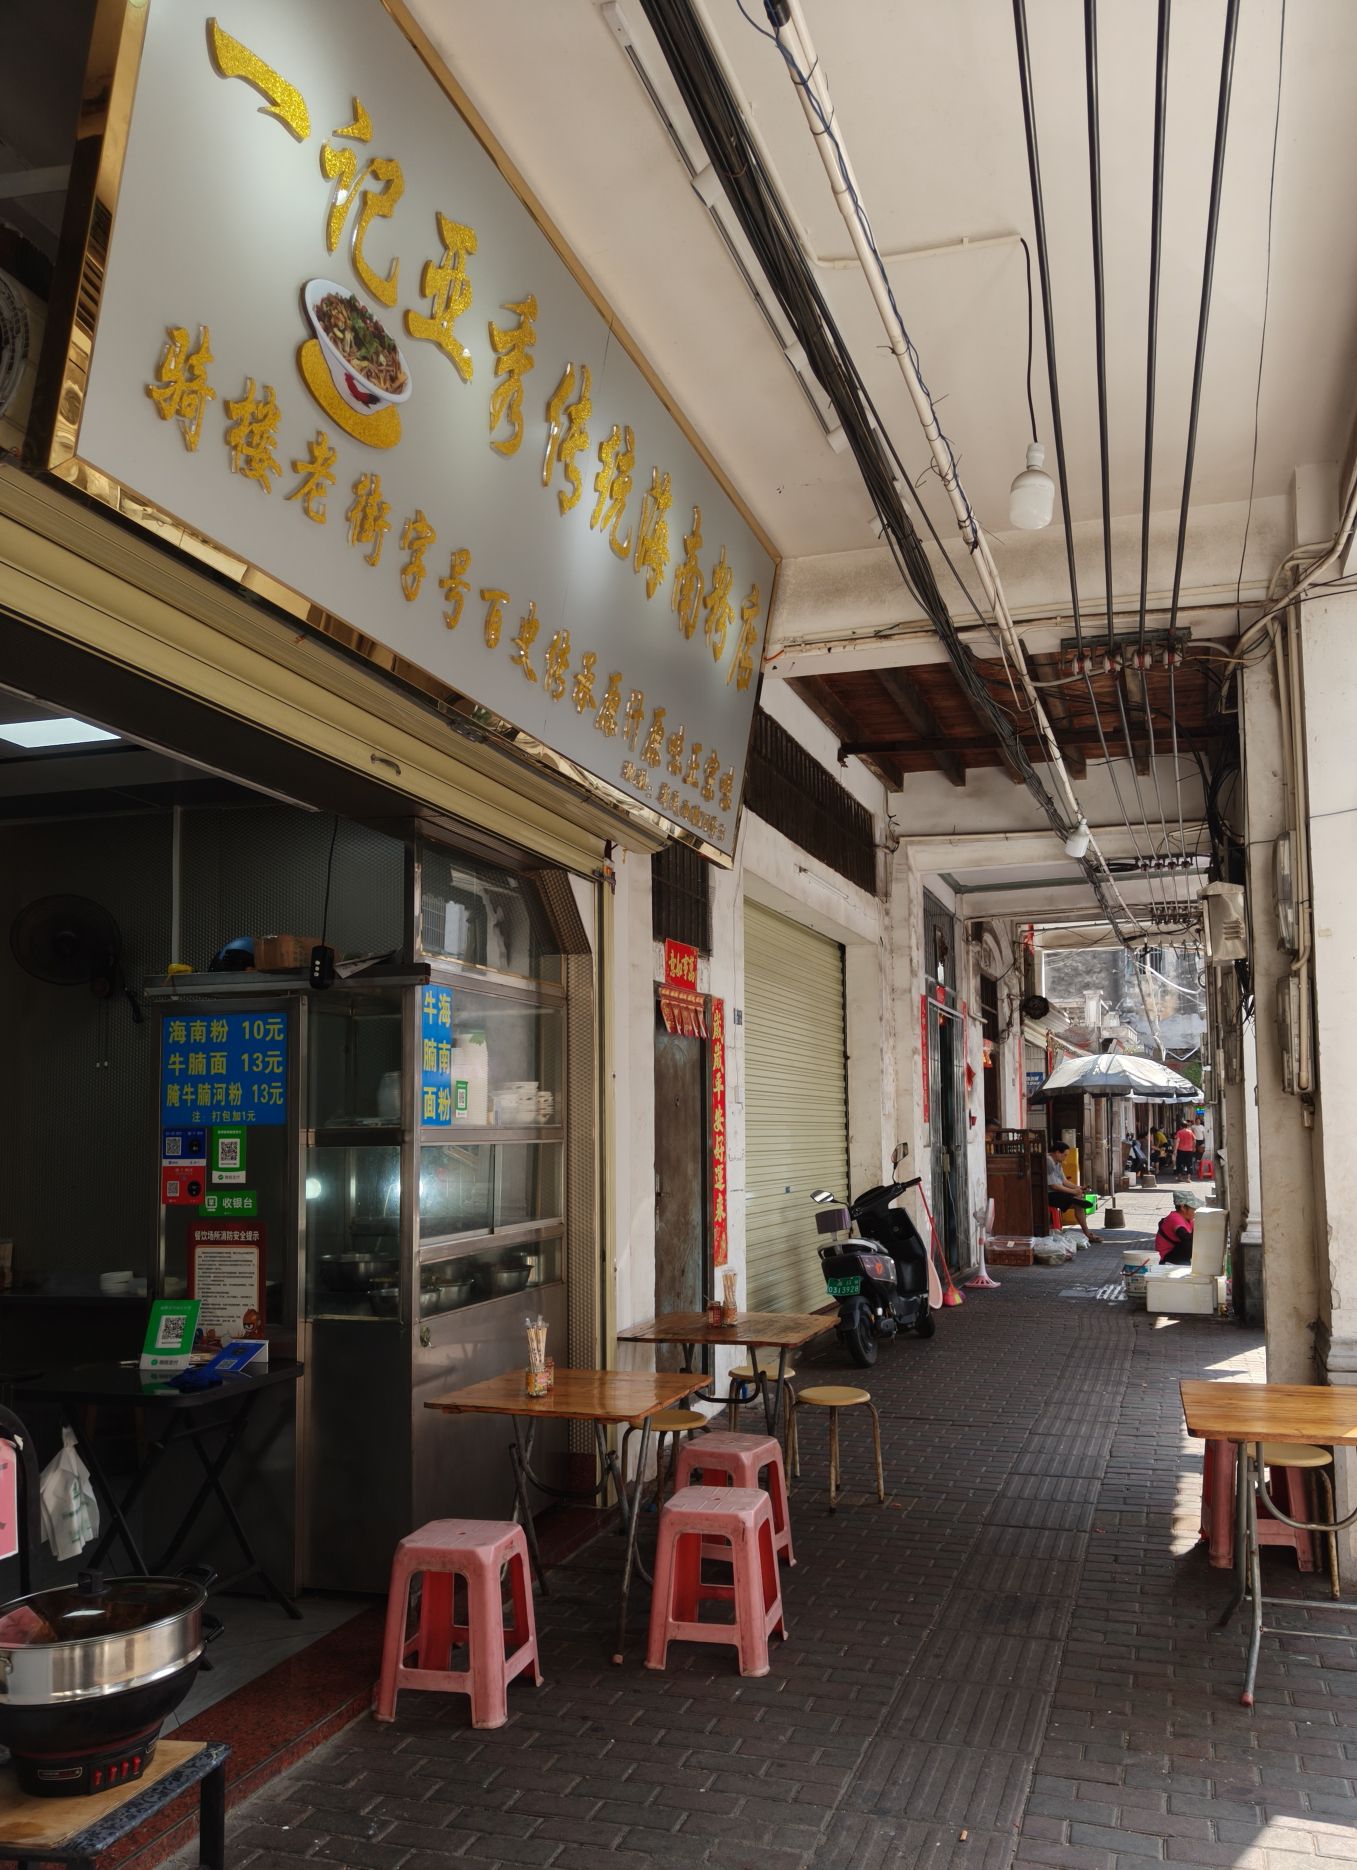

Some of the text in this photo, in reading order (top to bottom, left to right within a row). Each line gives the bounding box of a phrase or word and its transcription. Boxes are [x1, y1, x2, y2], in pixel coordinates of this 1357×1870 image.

[169, 1018, 284, 1044] 海南粉 10元
[167, 1051, 283, 1077] 牛腩面 13元
[423, 990, 437, 1120] 牛腩面
[438, 993, 451, 1121] 海南粉
[252, 1082, 284, 1105] 13元
[222, 1197, 253, 1209] 收银台
[194, 1230, 260, 1242] 餐饮场所消防安全提示
